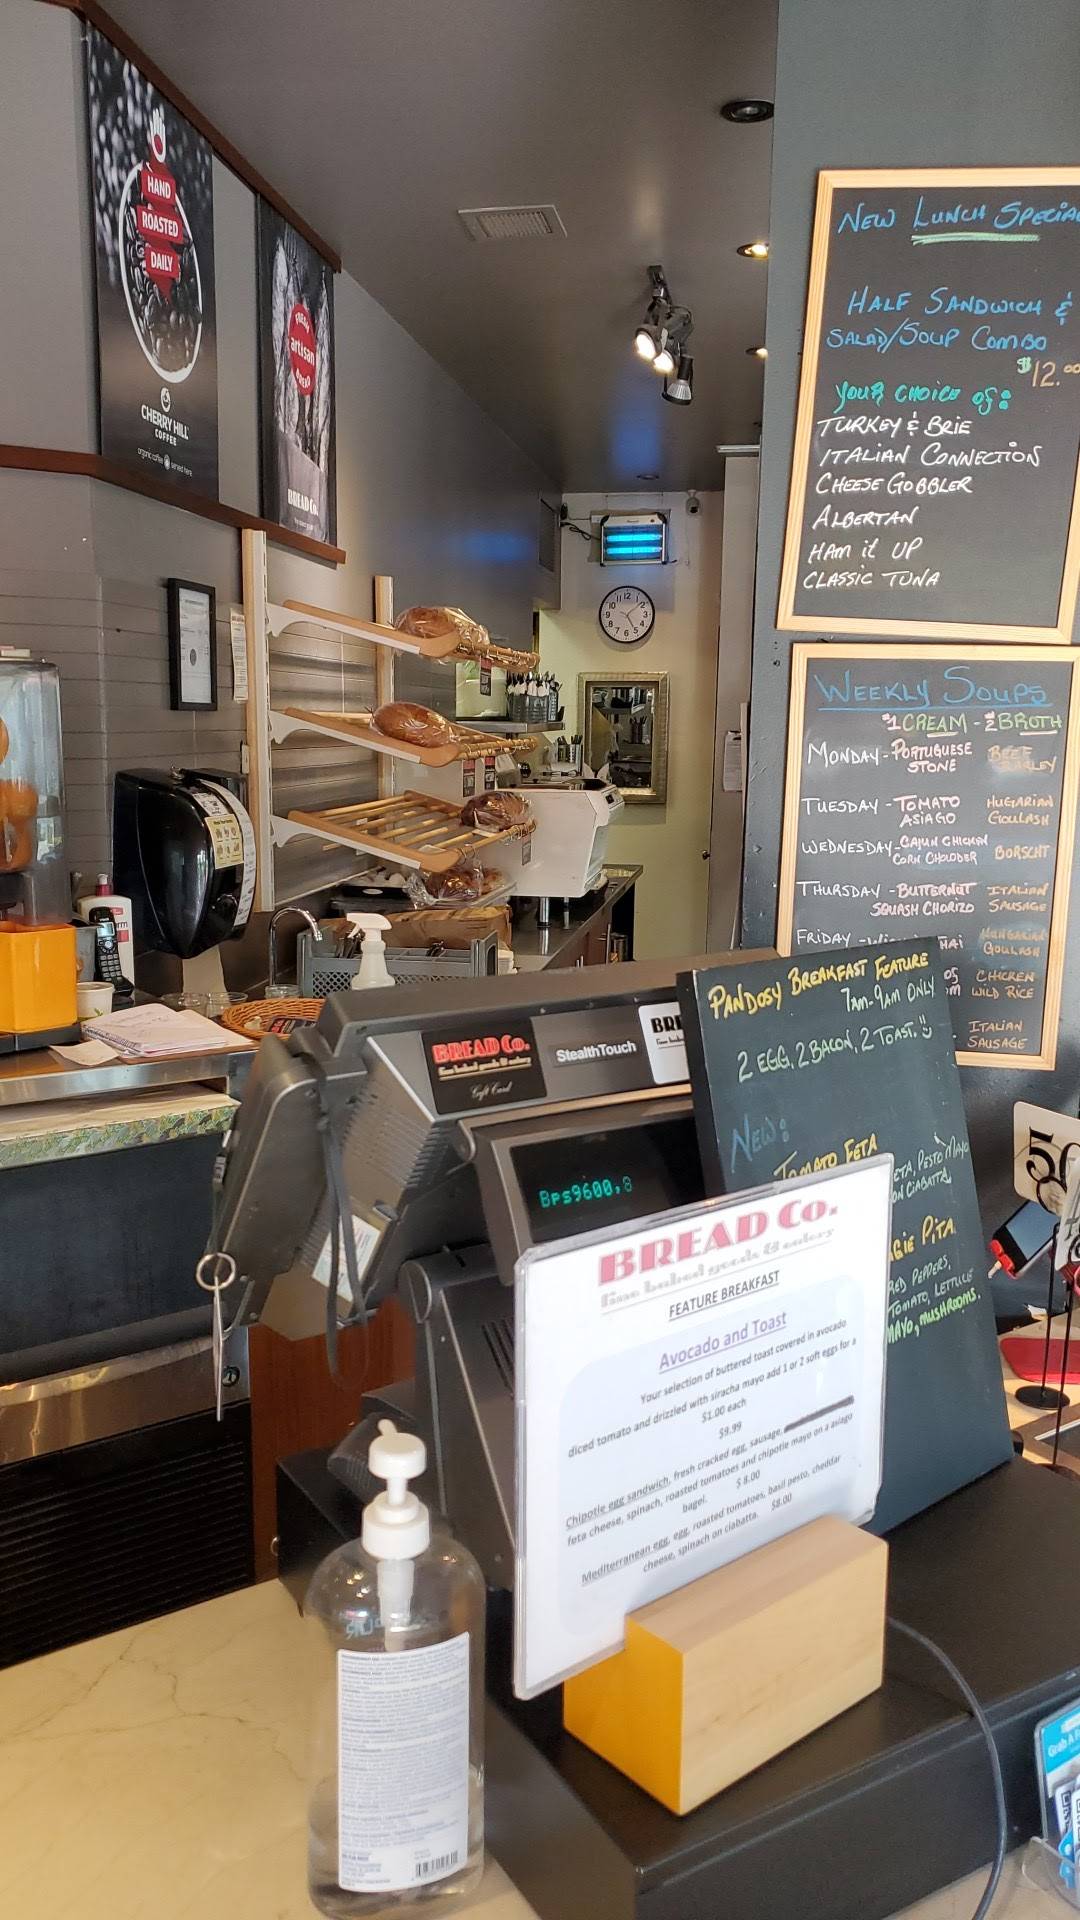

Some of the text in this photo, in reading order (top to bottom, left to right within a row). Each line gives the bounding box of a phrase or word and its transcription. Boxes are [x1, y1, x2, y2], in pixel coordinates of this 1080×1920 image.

[147, 176, 171, 199] HAND
[142, 211, 178, 238] ROASTED
[838, 202, 896, 233] NEW
[912, 196, 986, 231] LUNCH
[151, 251, 173, 272] DAILY
[847, 286, 912, 315] HALF
[924, 286, 1042, 315] SANDWICH
[971, 325, 1047, 351] COMBO
[290, 337, 315, 366] artisan
[141, 404, 189, 440] CHERRY HILL
[817, 415, 902, 438] TURKEY
[924, 415, 972, 436] BRIE
[155, 428, 177, 446] COFFEE
[819, 441, 1042, 467] ITALIAN CONNECTION
[815, 472, 973, 495] CHEESE GOBBLER
[287, 488, 310, 512] BREAD
[812, 504, 919, 530] ALBERTAN
[803, 565, 941, 589] CLASSIC TUNA
[814, 666, 1047, 708] WEEKLY SOUPS
[902, 712, 1062, 734] CREAM BROTH
[807, 738, 973, 768] MONDAY PORTUGUESE
[907, 759, 957, 774] STONE
[801, 794, 960, 815] TUESDAY TOMATO
[900, 811, 956, 828] ASIAGO
[801, 839, 893, 858] WEDNESDAY
[796, 880, 978, 899] THURSDAY BUTTERNUT
[922, 897, 975, 916] CHORIZO
[988, 899, 1048, 913] SAUSAGE
[796, 928, 851, 947] FRIDAY
[707, 952, 929, 1020] PANDOSY BREAKFAST FEATURE
[907, 974, 934, 1002] ONLY
[968, 1018, 1023, 1034] ITALIAN
[432, 1034, 531, 1064] BREAD Co.
[556, 1040, 637, 1063] StealthTouch
[737, 1052, 754, 1083] 2
[861, 1027, 875, 1052] 2
[967, 1035, 1028, 1050] SAUSAGE
[843, 1132, 878, 1164] FETA
[917, 1149, 944, 1171] PESTO
[598, 1198, 838, 1287] BREAD Co.
[669, 1270, 780, 1318] FEATURE BREAKFAST
[659, 1312, 787, 1370] Avocado and Toast
[640, 1319, 847, 1405] Your selection of buttered toast covered in avocado
[568, 1340, 850, 1458] diced tomato and drizzled with siracha mayo add or soft eggs for
[702, 1397, 747, 1424] $1.00 each
[719, 1421, 742, 1440] $9.99
[589, 1515, 624, 1537] cheese,
[626, 1497, 663, 1521] spinach,
[665, 1481, 698, 1503] roasted
[700, 1463, 739, 1487] tomatoes
[741, 1454, 756, 1469] and
[758, 1441, 789, 1462] chipotle
[791, 1432, 812, 1446] mayo
[813, 1426, 823, 1436] on
[830, 1413, 853, 1429] asiago
[566, 1503, 606, 1529] Chipotle
[608, 1494, 625, 1511] egg
[626, 1476, 671, 1501] sandwich,
[673, 1464, 696, 1480] fresh
[697, 1450, 730, 1470] cracked
[682, 1494, 708, 1514] bagel.
[581, 1543, 652, 1584] Mediterranean
[692, 1507, 724, 1531] roasted
[726, 1491, 766, 1514] tomatoes,
[768, 1479, 786, 1496] basil
[811, 1455, 841, 1474] cheddar
[643, 1550, 676, 1573] cheese,
[678, 1533, 711, 1557] spinach
[712, 1527, 723, 1539] on
[724, 1511, 759, 1534] ciabatta.
